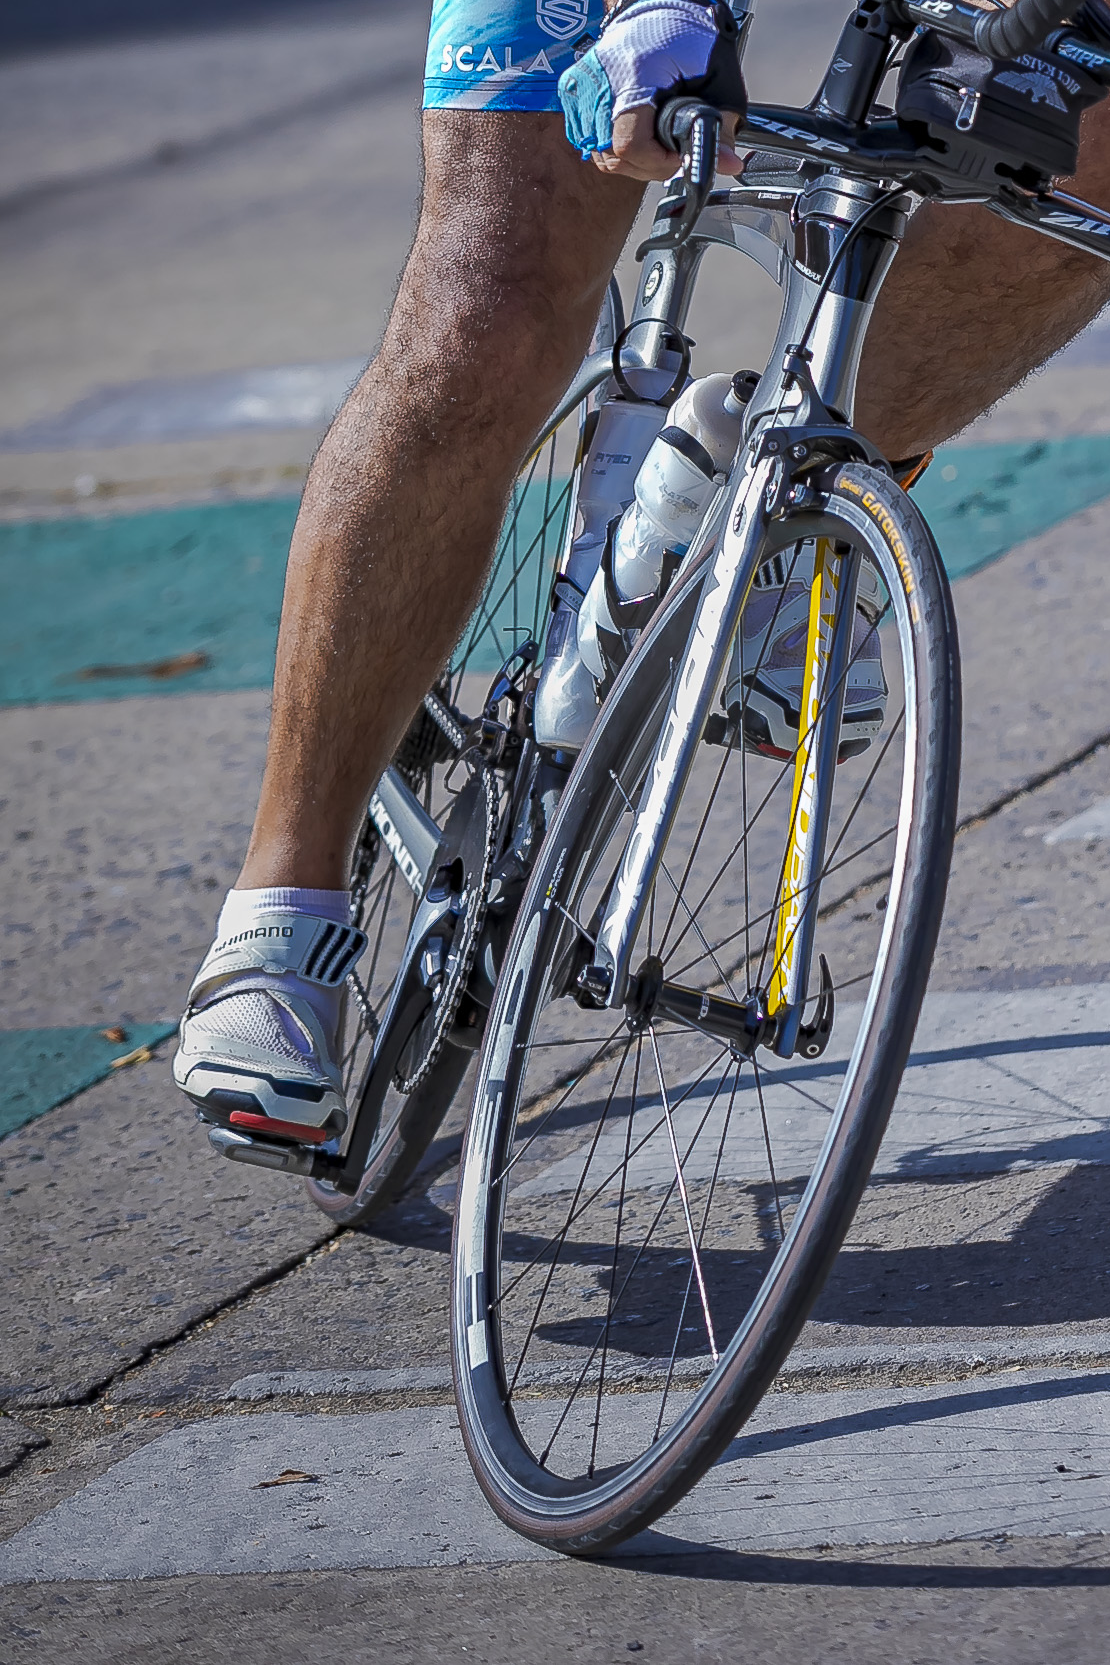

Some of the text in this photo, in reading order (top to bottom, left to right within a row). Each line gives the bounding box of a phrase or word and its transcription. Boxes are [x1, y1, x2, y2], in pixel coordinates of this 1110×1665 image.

[440, 44, 554, 73] SCALA
[1057, 42, 1106, 69] ZIPP
[862, 491, 916, 595] GATORSKIN
[777, 538, 842, 1003] IAMONDBACK
[214, 926, 294, 953] SHIMANO
